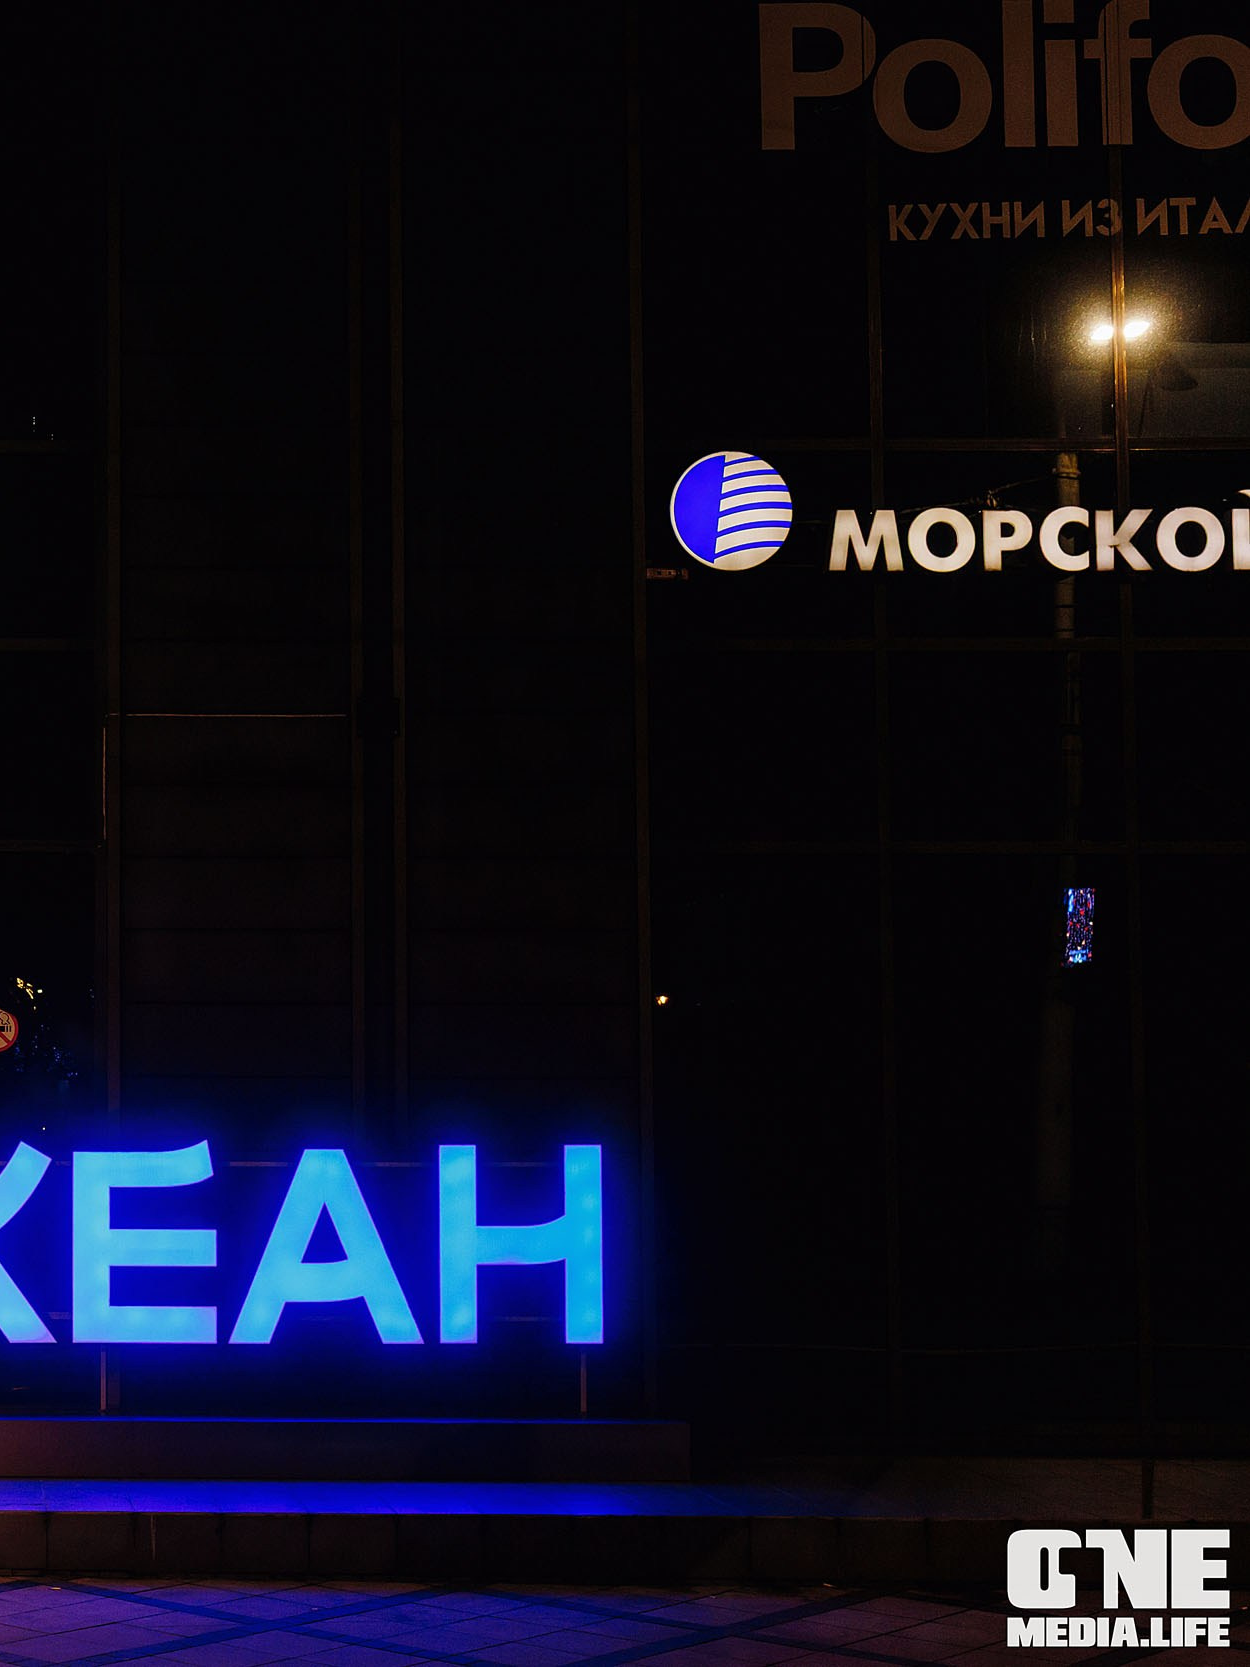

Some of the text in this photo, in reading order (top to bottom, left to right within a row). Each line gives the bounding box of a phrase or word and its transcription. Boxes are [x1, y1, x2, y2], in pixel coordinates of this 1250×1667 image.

[758, 0, 1250, 153] Polifo
[888, 200, 1046, 242] КУХНИ
[1061, 198, 1122, 238] ИЗ
